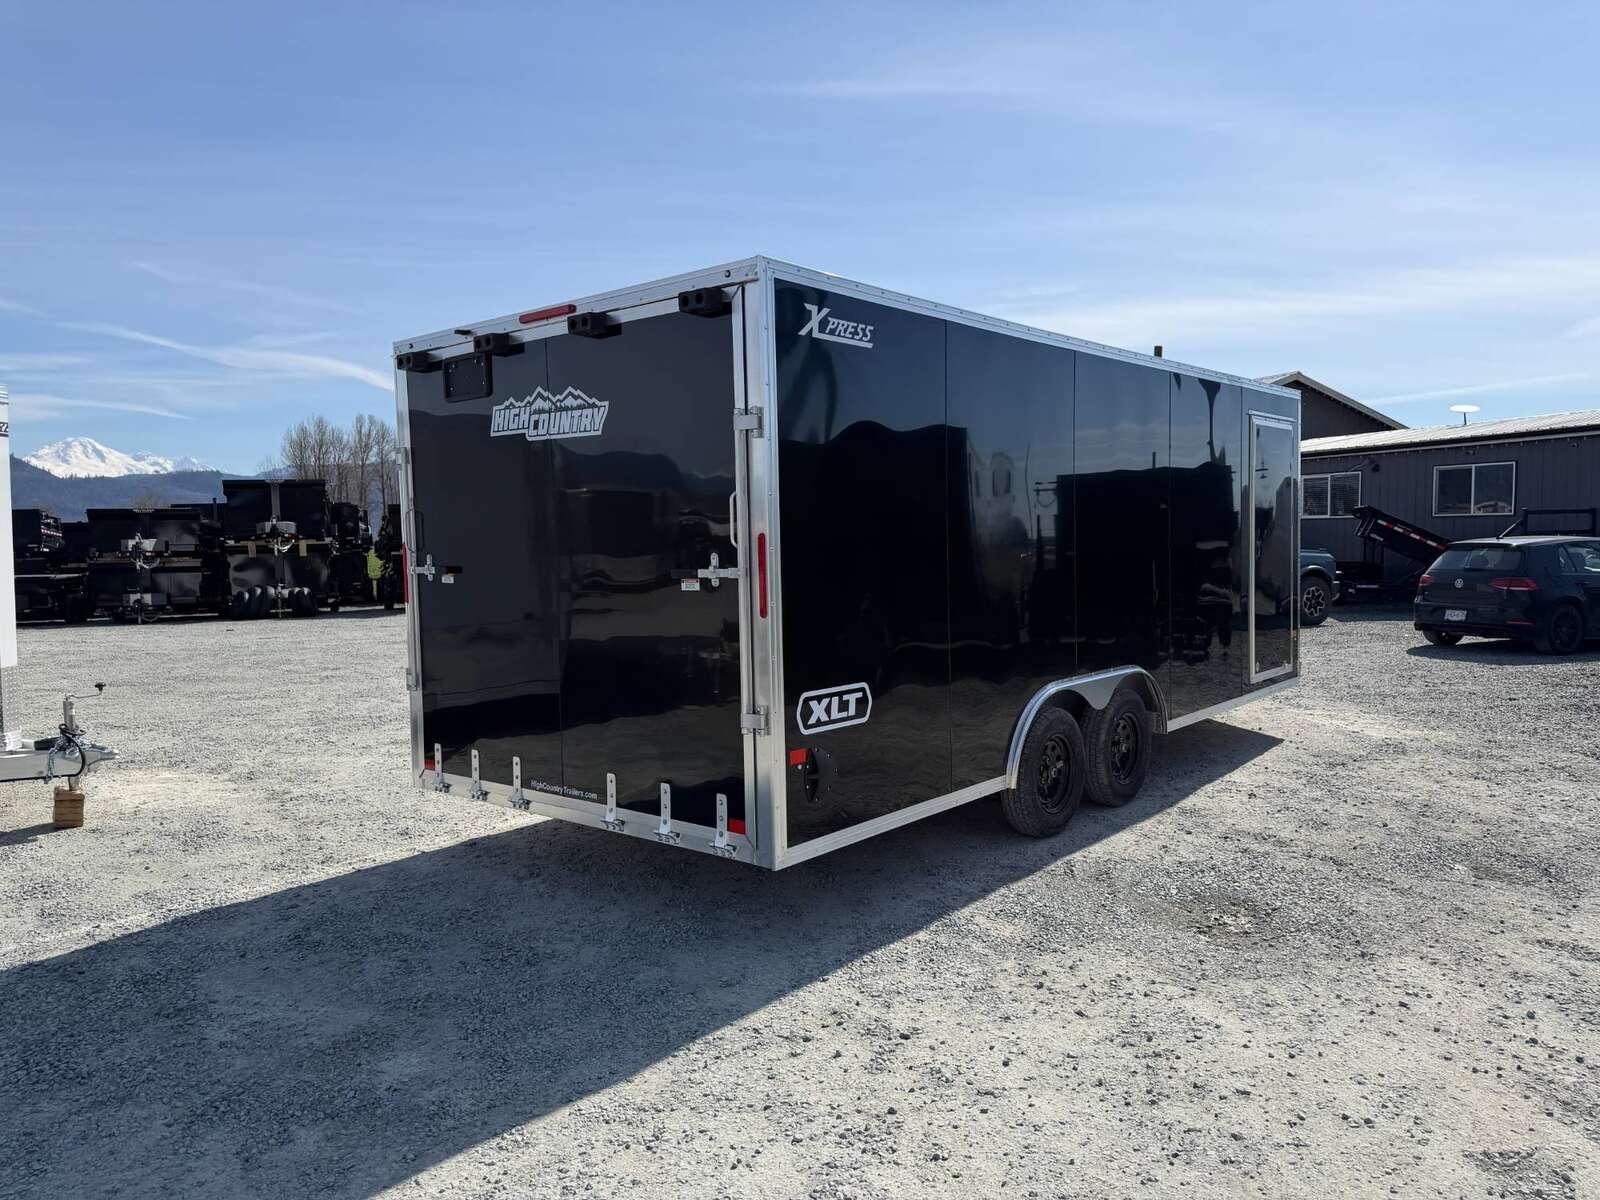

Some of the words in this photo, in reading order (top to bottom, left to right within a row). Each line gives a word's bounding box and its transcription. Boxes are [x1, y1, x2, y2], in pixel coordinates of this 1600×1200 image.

[493, 406, 532, 432] HIGH
[528, 405, 605, 436] COUNTRY
[807, 691, 863, 725] XLT
